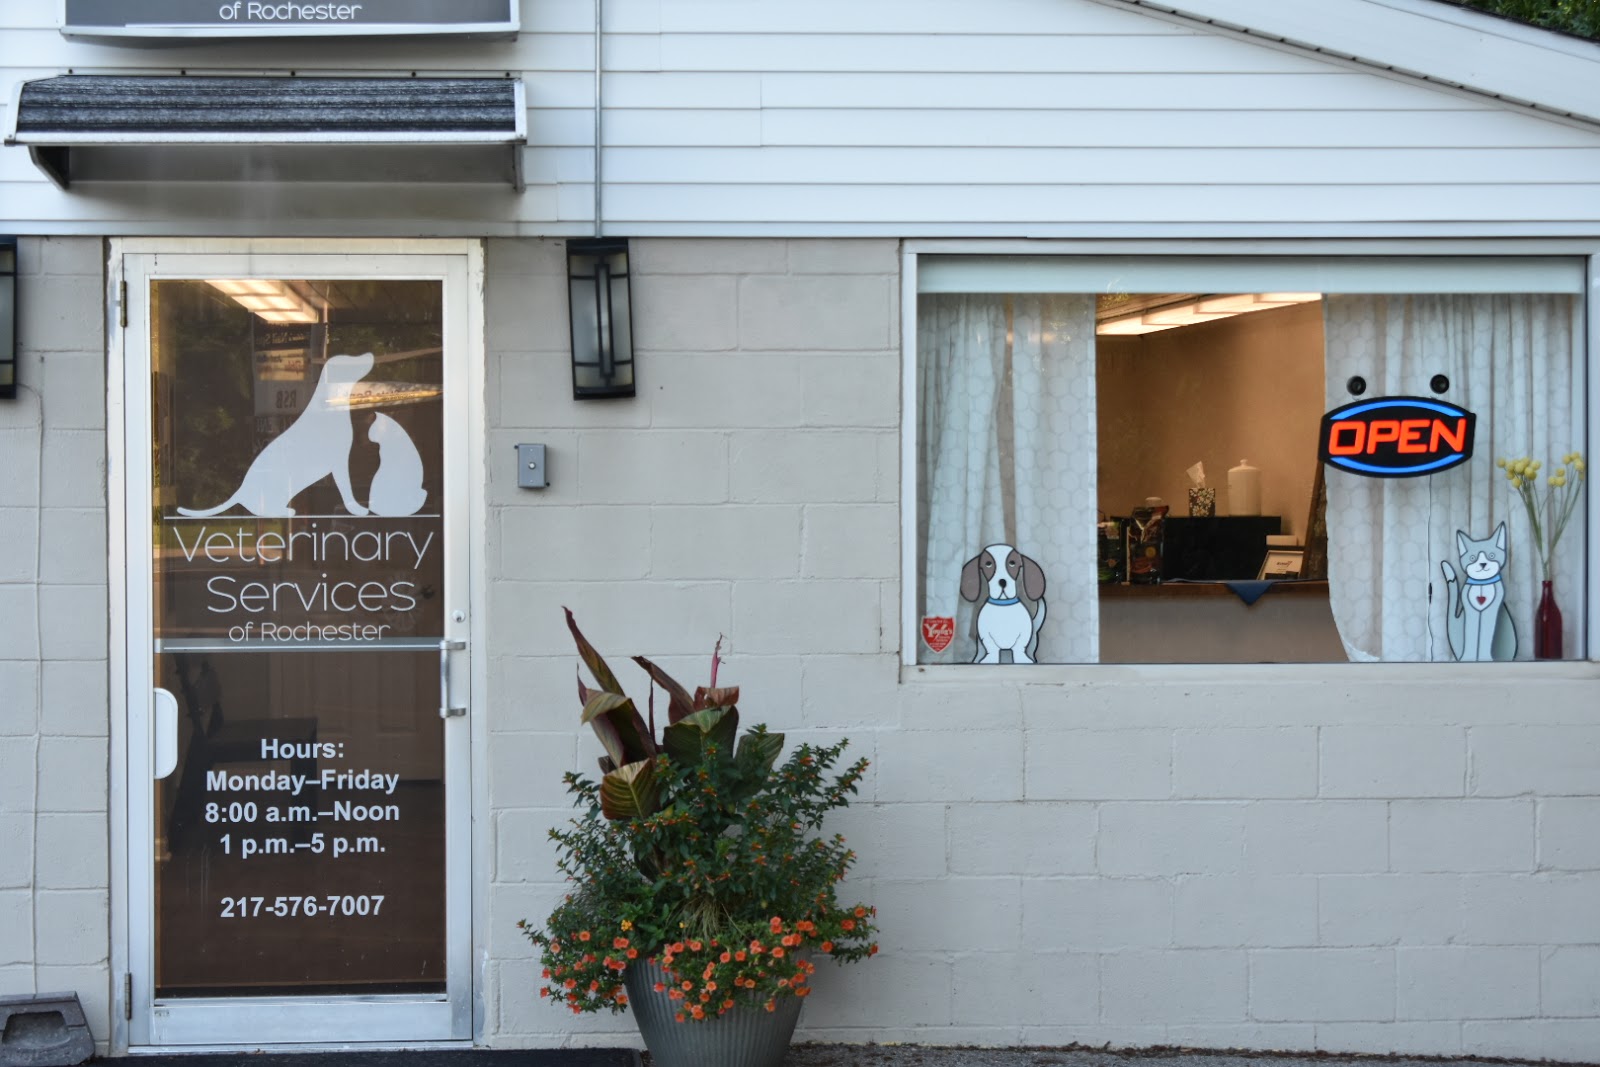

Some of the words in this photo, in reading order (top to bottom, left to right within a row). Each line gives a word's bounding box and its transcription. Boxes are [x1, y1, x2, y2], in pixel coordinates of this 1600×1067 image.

[219, 1, 242, 20] of
[247, 1, 363, 20] Rochester
[1328, 418, 1467, 456] OPEN
[173, 522, 434, 570] Veterinary
[206, 572, 416, 613] Services
[228, 621, 254, 642] of
[261, 621, 391, 642] Rochester
[261, 738, 344, 759] Hours:
[205, 802, 258, 823] 8:00
[219, 833, 231, 854] 1
[333, 836, 386, 858] p.m.
[220, 895, 385, 918] 217-576-7007
